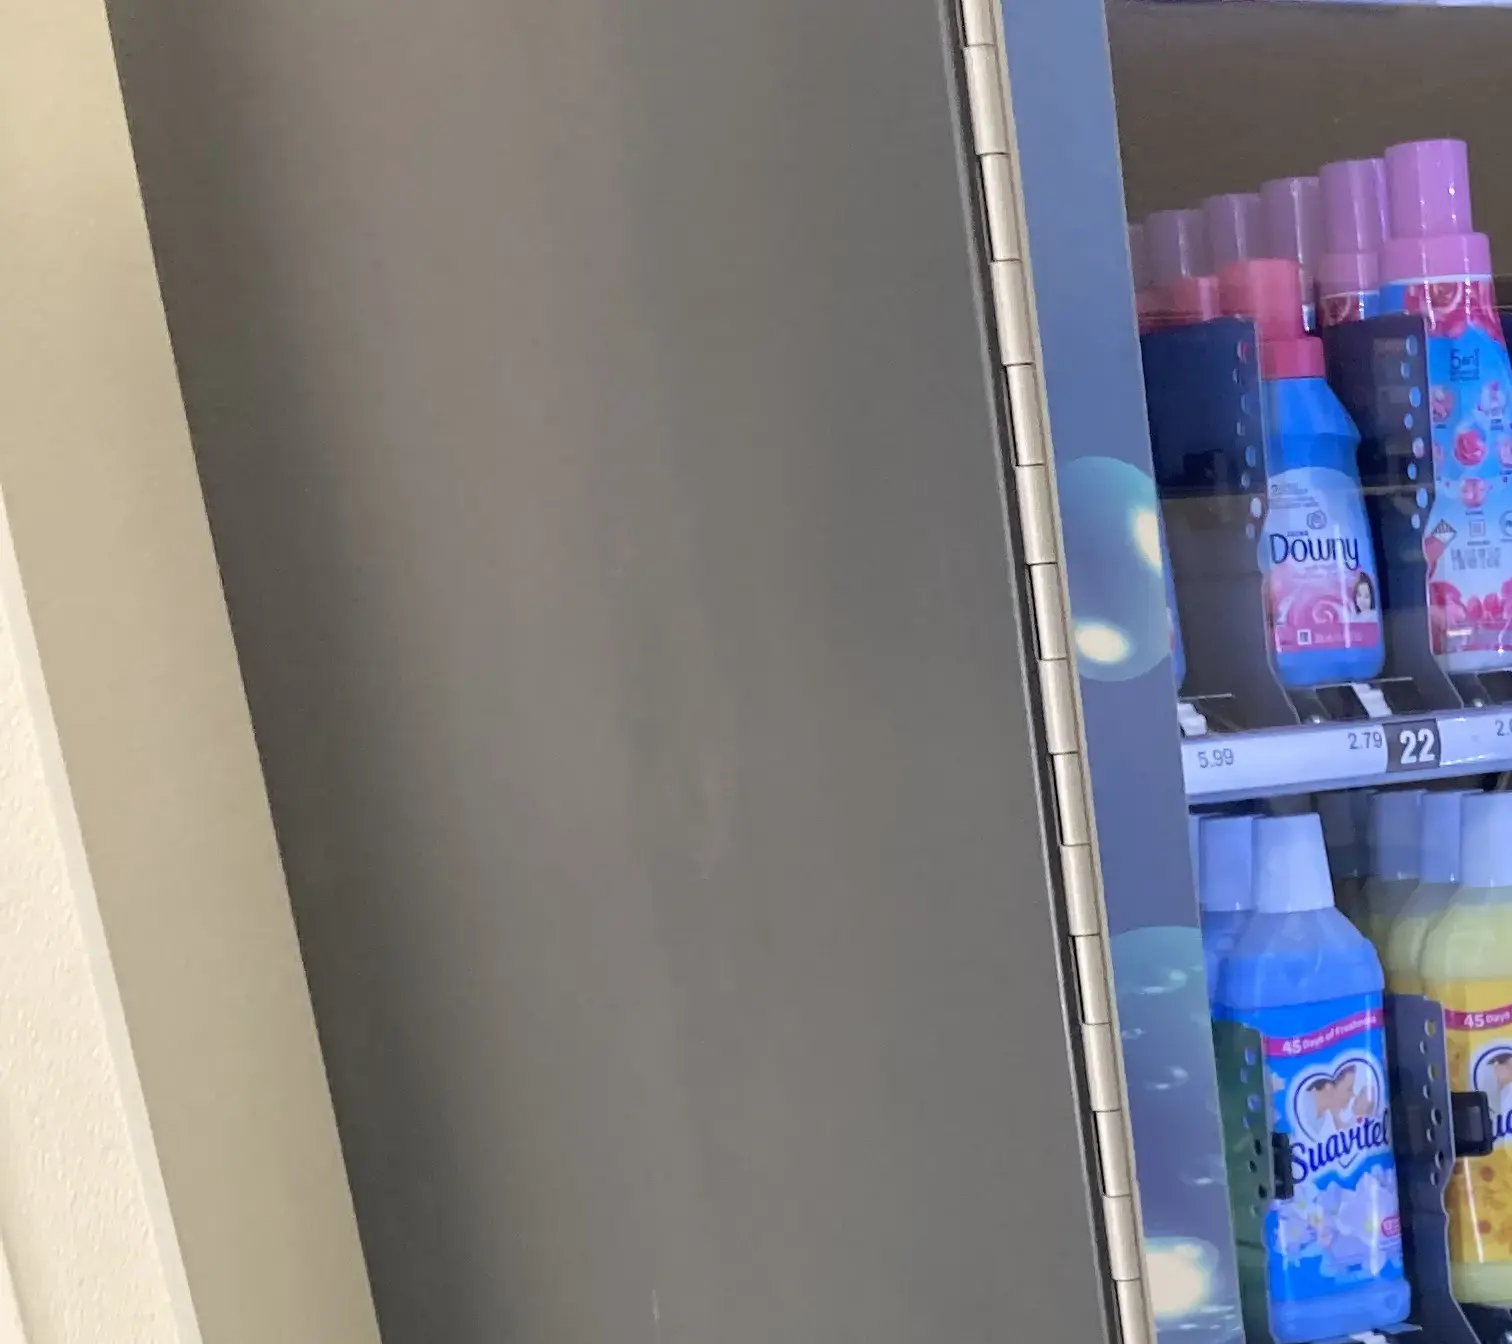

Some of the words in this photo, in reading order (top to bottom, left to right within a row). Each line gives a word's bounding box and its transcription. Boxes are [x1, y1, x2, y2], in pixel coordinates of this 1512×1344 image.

[1269, 533, 1359, 570] Downy
[1348, 731, 1382, 750] 2.79
[1400, 728, 1435, 765] 22
[1198, 748, 1234, 769] 5.99
[1463, 1014, 1485, 1028] 45
[1283, 1037, 1302, 1056] 45
[1290, 1109, 1389, 1185] Suavitel
